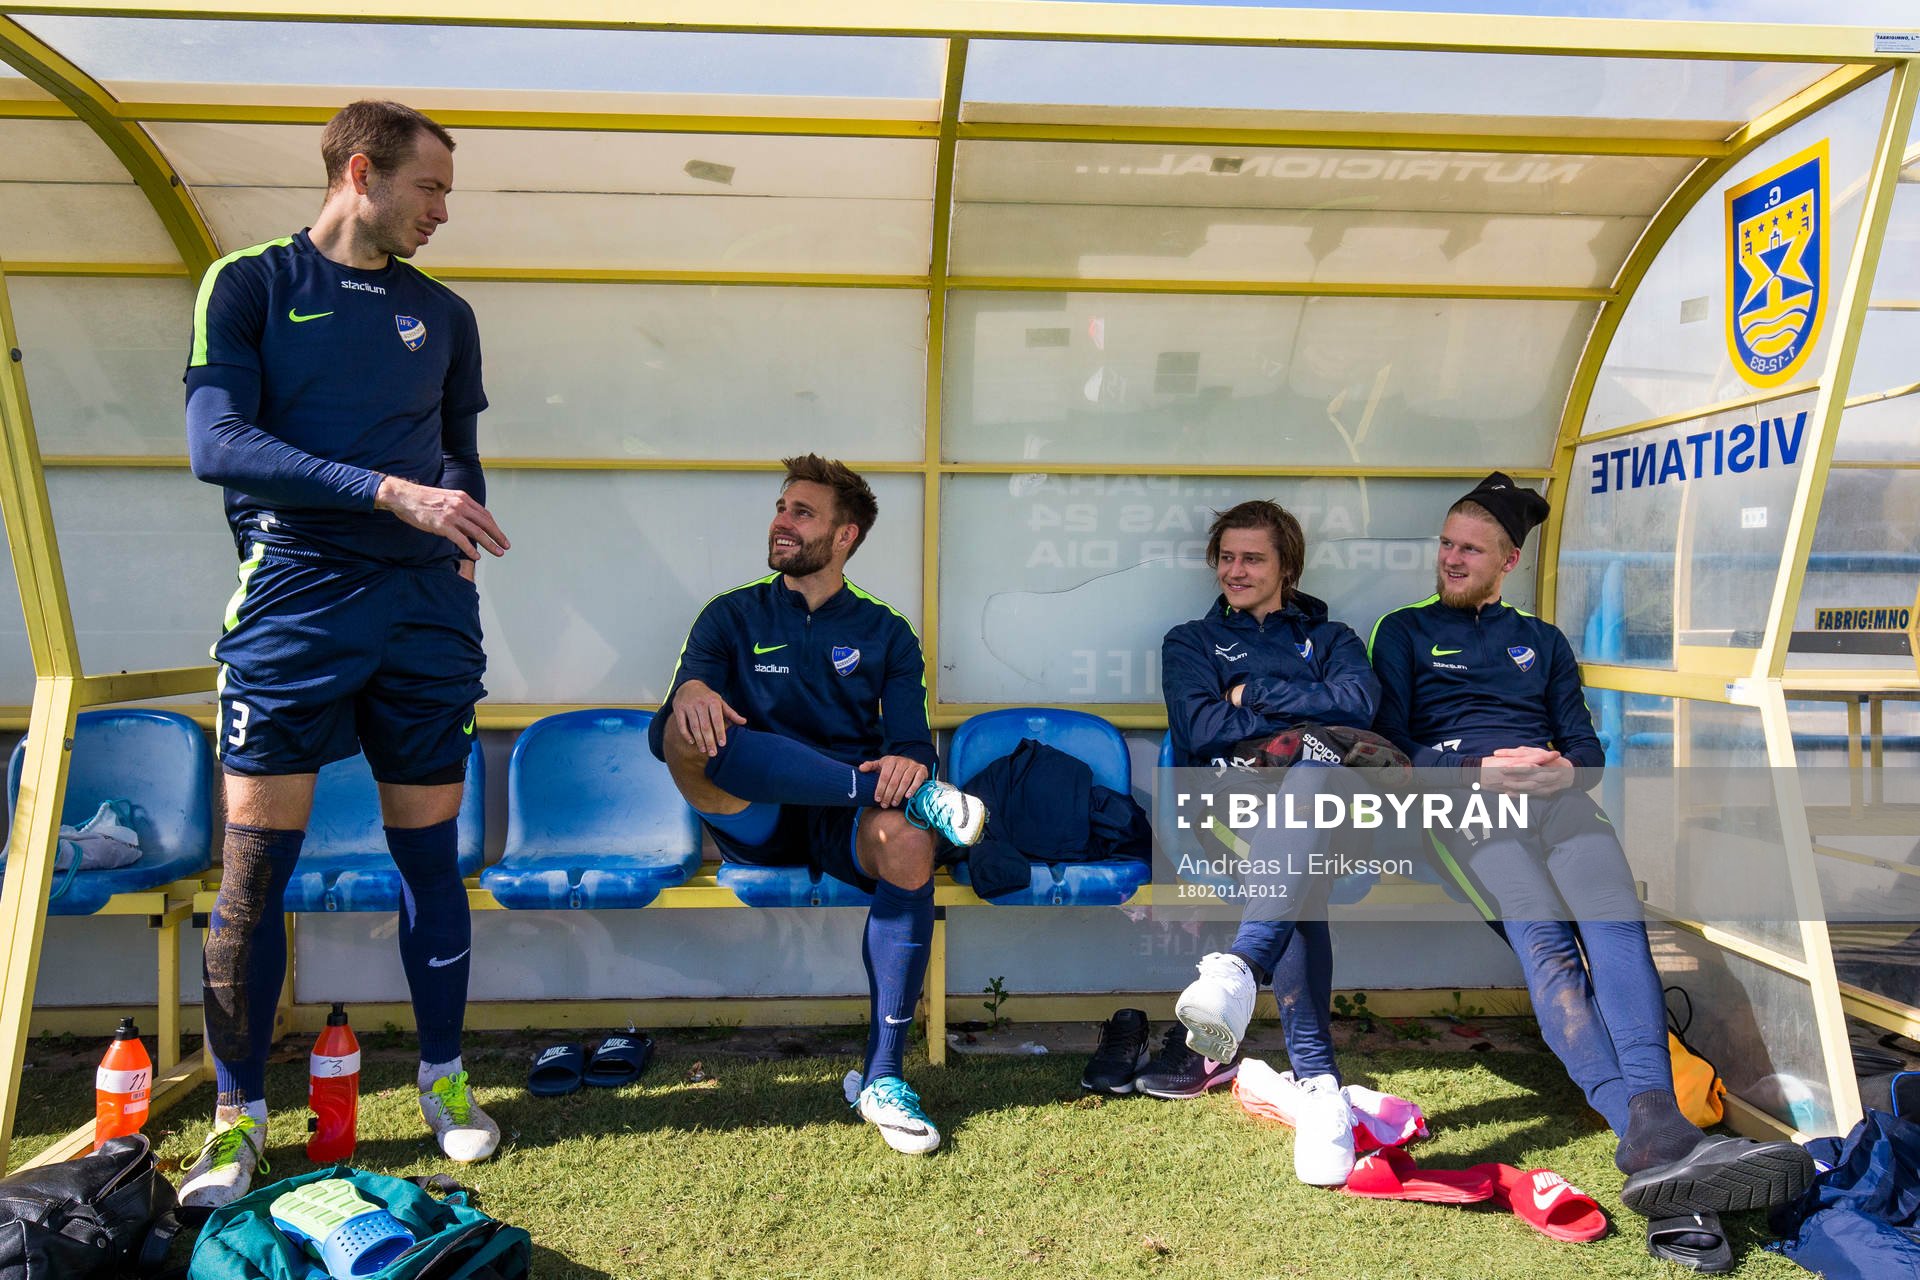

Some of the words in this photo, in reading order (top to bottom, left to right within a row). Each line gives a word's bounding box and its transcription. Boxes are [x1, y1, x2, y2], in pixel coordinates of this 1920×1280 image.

[341, 280, 386, 295] stadium
[754, 663, 790, 674] stadium
[229, 701, 250, 747] 3
[1302, 733, 1341, 764] adidas
[603, 1038, 630, 1048] NIKE
[543, 1046, 569, 1058] NIKE
